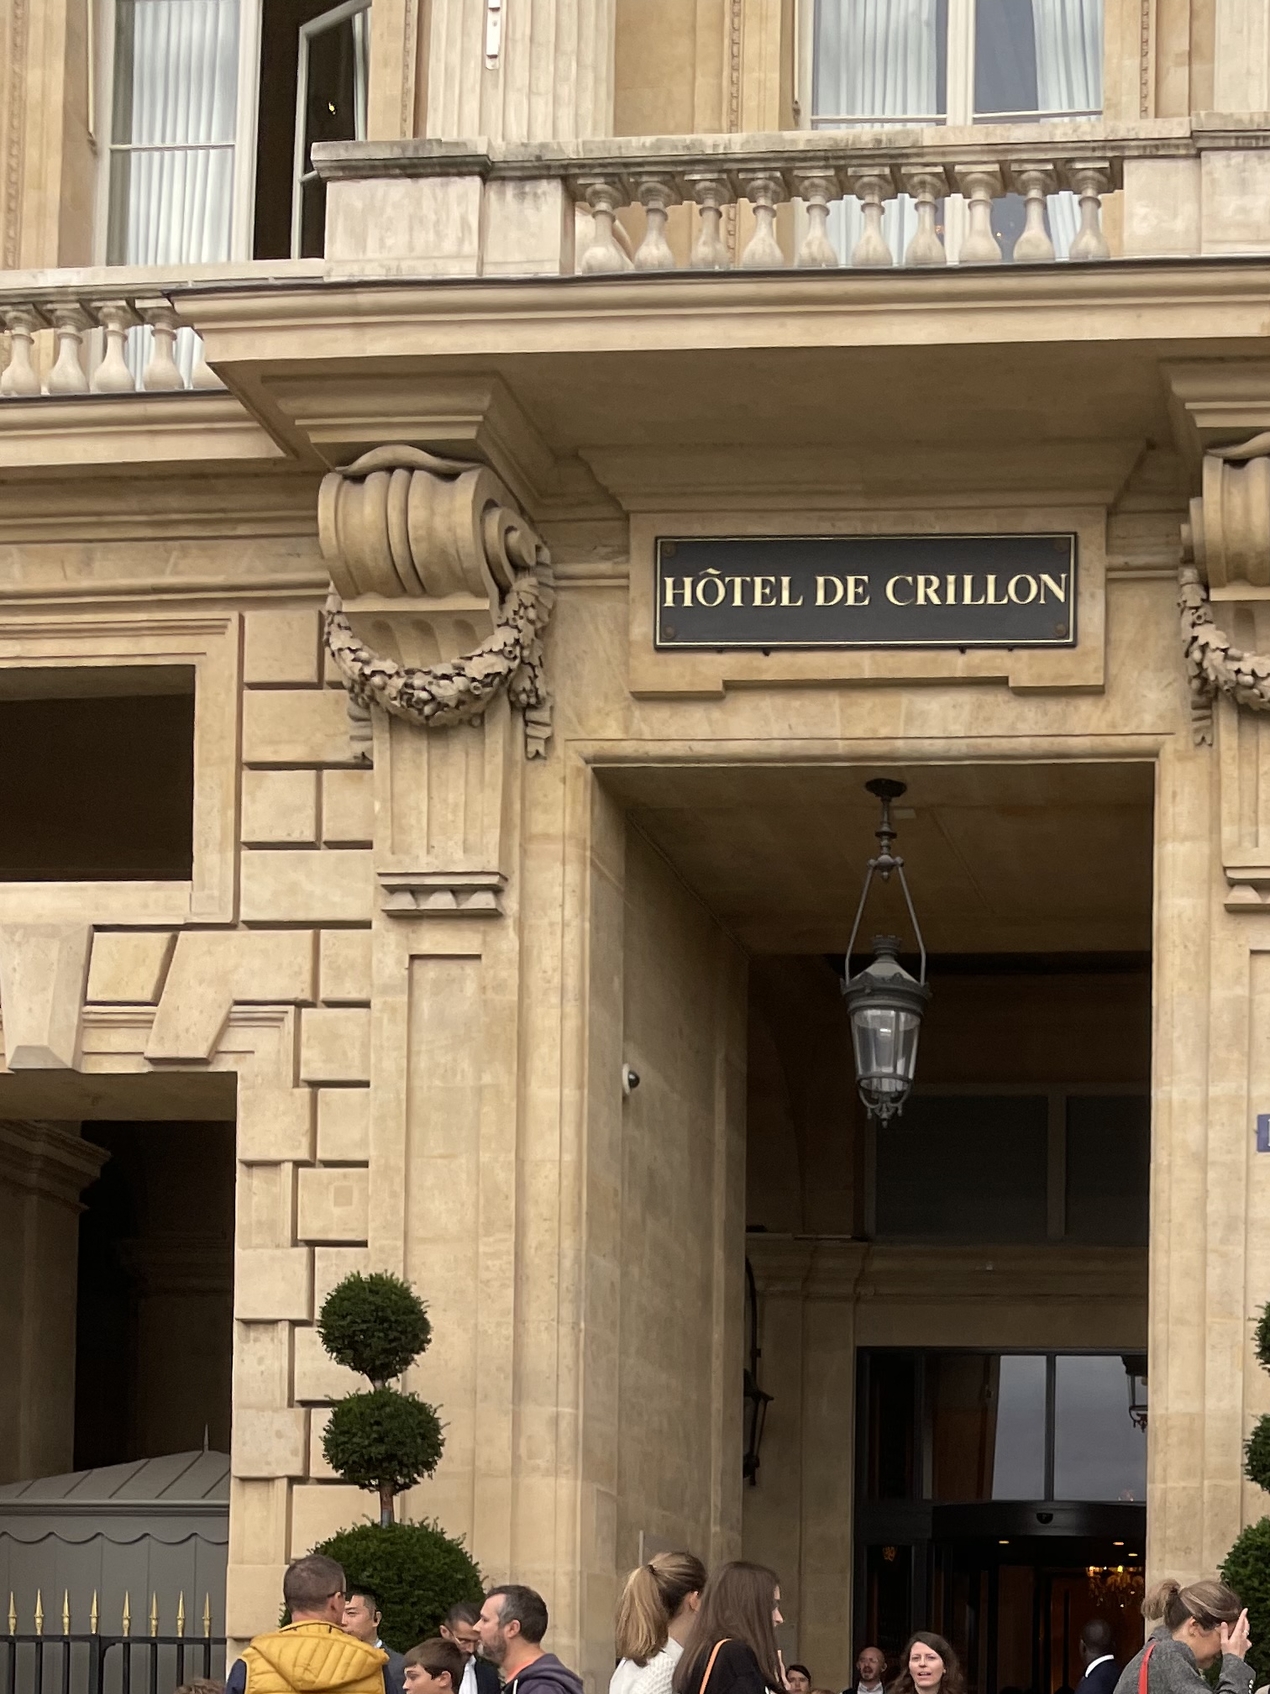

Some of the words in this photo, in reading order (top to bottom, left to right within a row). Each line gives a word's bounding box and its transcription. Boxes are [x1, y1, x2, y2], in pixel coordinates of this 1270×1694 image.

[663, 568, 803, 608] HÔTEL
[815, 575, 870, 607] DE
[885, 572, 1068, 606] CRILLON
